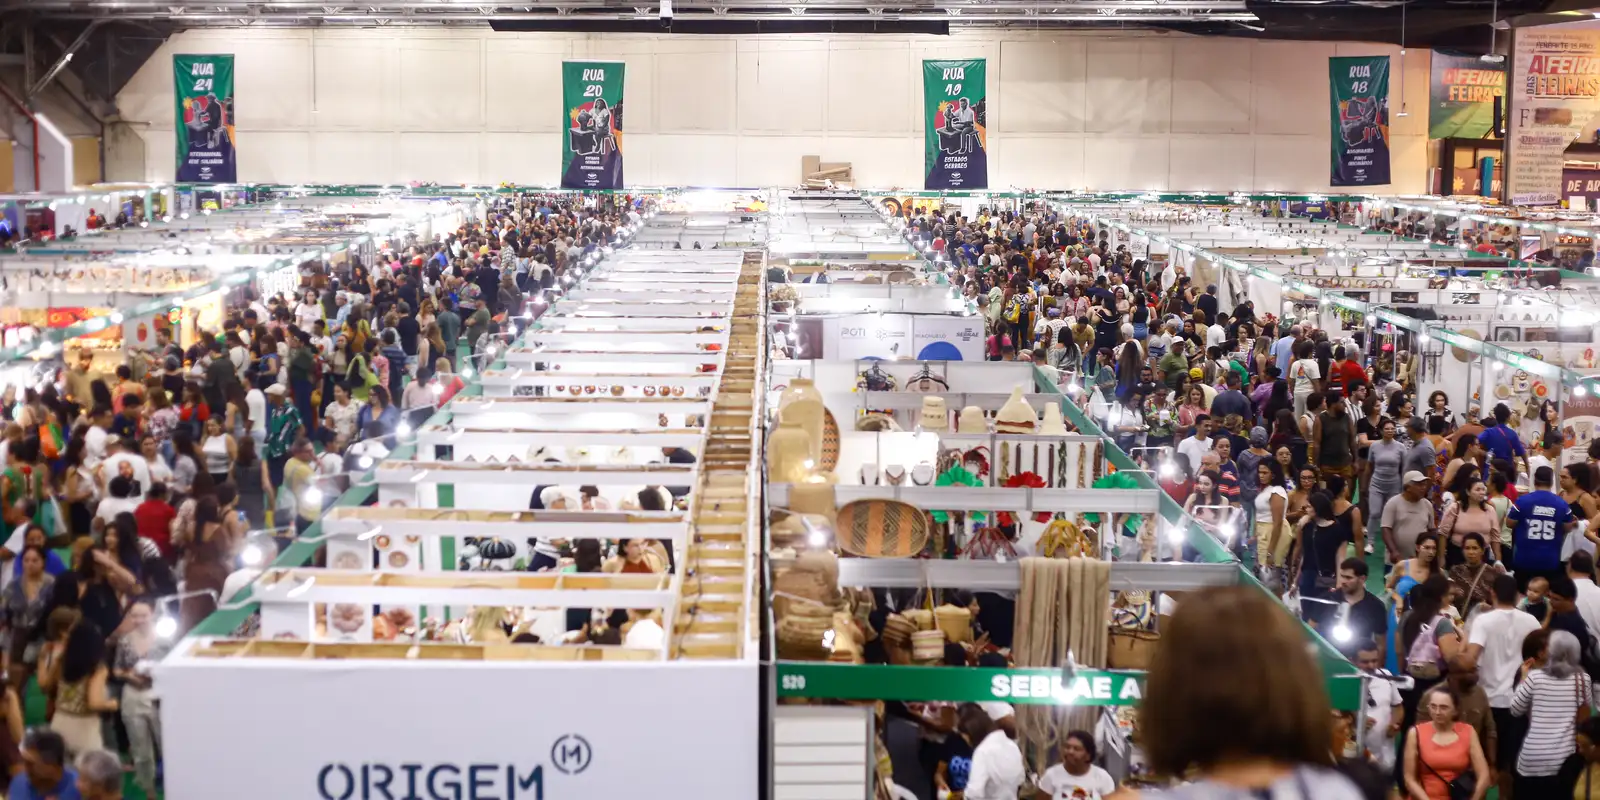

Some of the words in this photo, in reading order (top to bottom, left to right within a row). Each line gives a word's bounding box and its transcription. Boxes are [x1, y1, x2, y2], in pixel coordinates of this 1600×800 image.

[192, 63, 214, 75] RUA
[1528, 55, 1543, 74] A
[582, 69, 605, 81] RUA
[942, 67, 965, 80] RUA
[1349, 65, 1371, 78] RUA
[1457, 69, 1504, 86] FEIRA
[193, 79, 213, 90] 21
[583, 85, 603, 97] 20
[945, 83, 962, 96] 19
[1351, 81, 1368, 93] 18
[1535, 76, 1598, 96] FEIRAS
[1567, 180, 1582, 192] DE
[317, 763, 543, 800] ORIGEM
